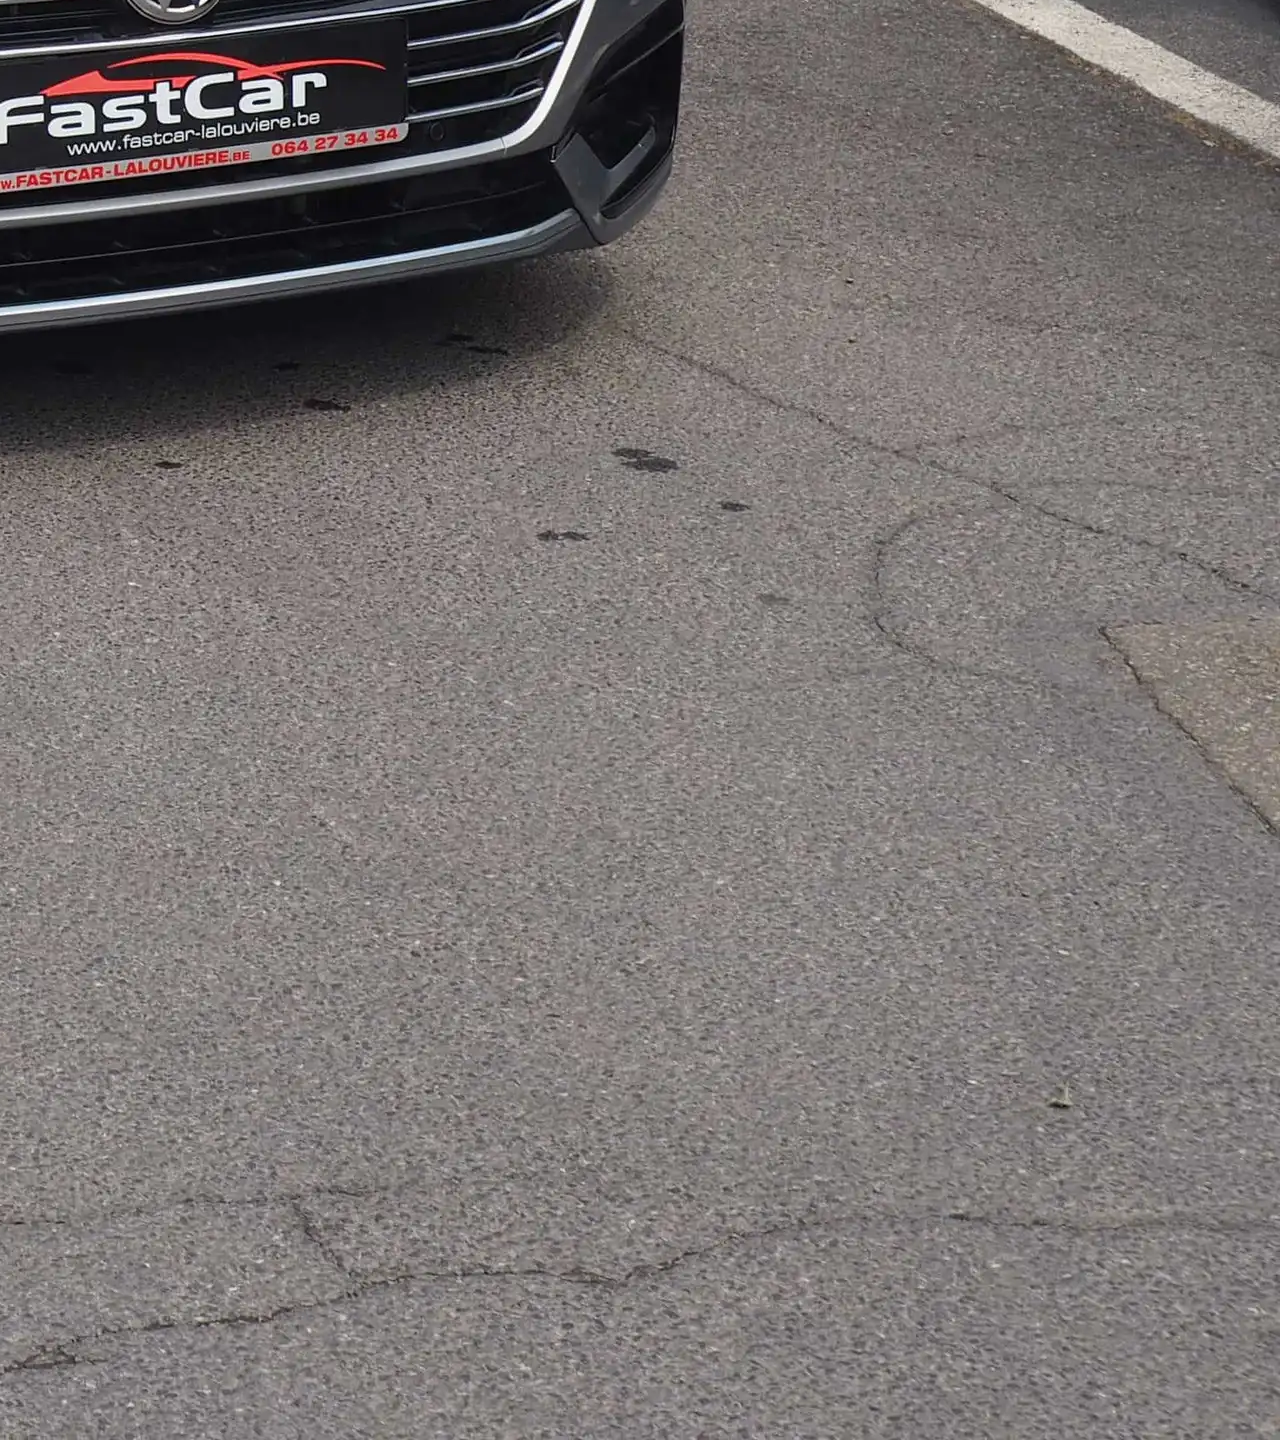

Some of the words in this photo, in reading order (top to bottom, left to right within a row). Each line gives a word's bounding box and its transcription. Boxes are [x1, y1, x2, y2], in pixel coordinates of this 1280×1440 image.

[67, 111, 321, 156] www.fastcar-lalouviere.be
[271, 139, 309, 156] 064
[314, 135, 339, 151] 27
[344, 131, 369, 147] 34
[374, 127, 398, 142] 34
